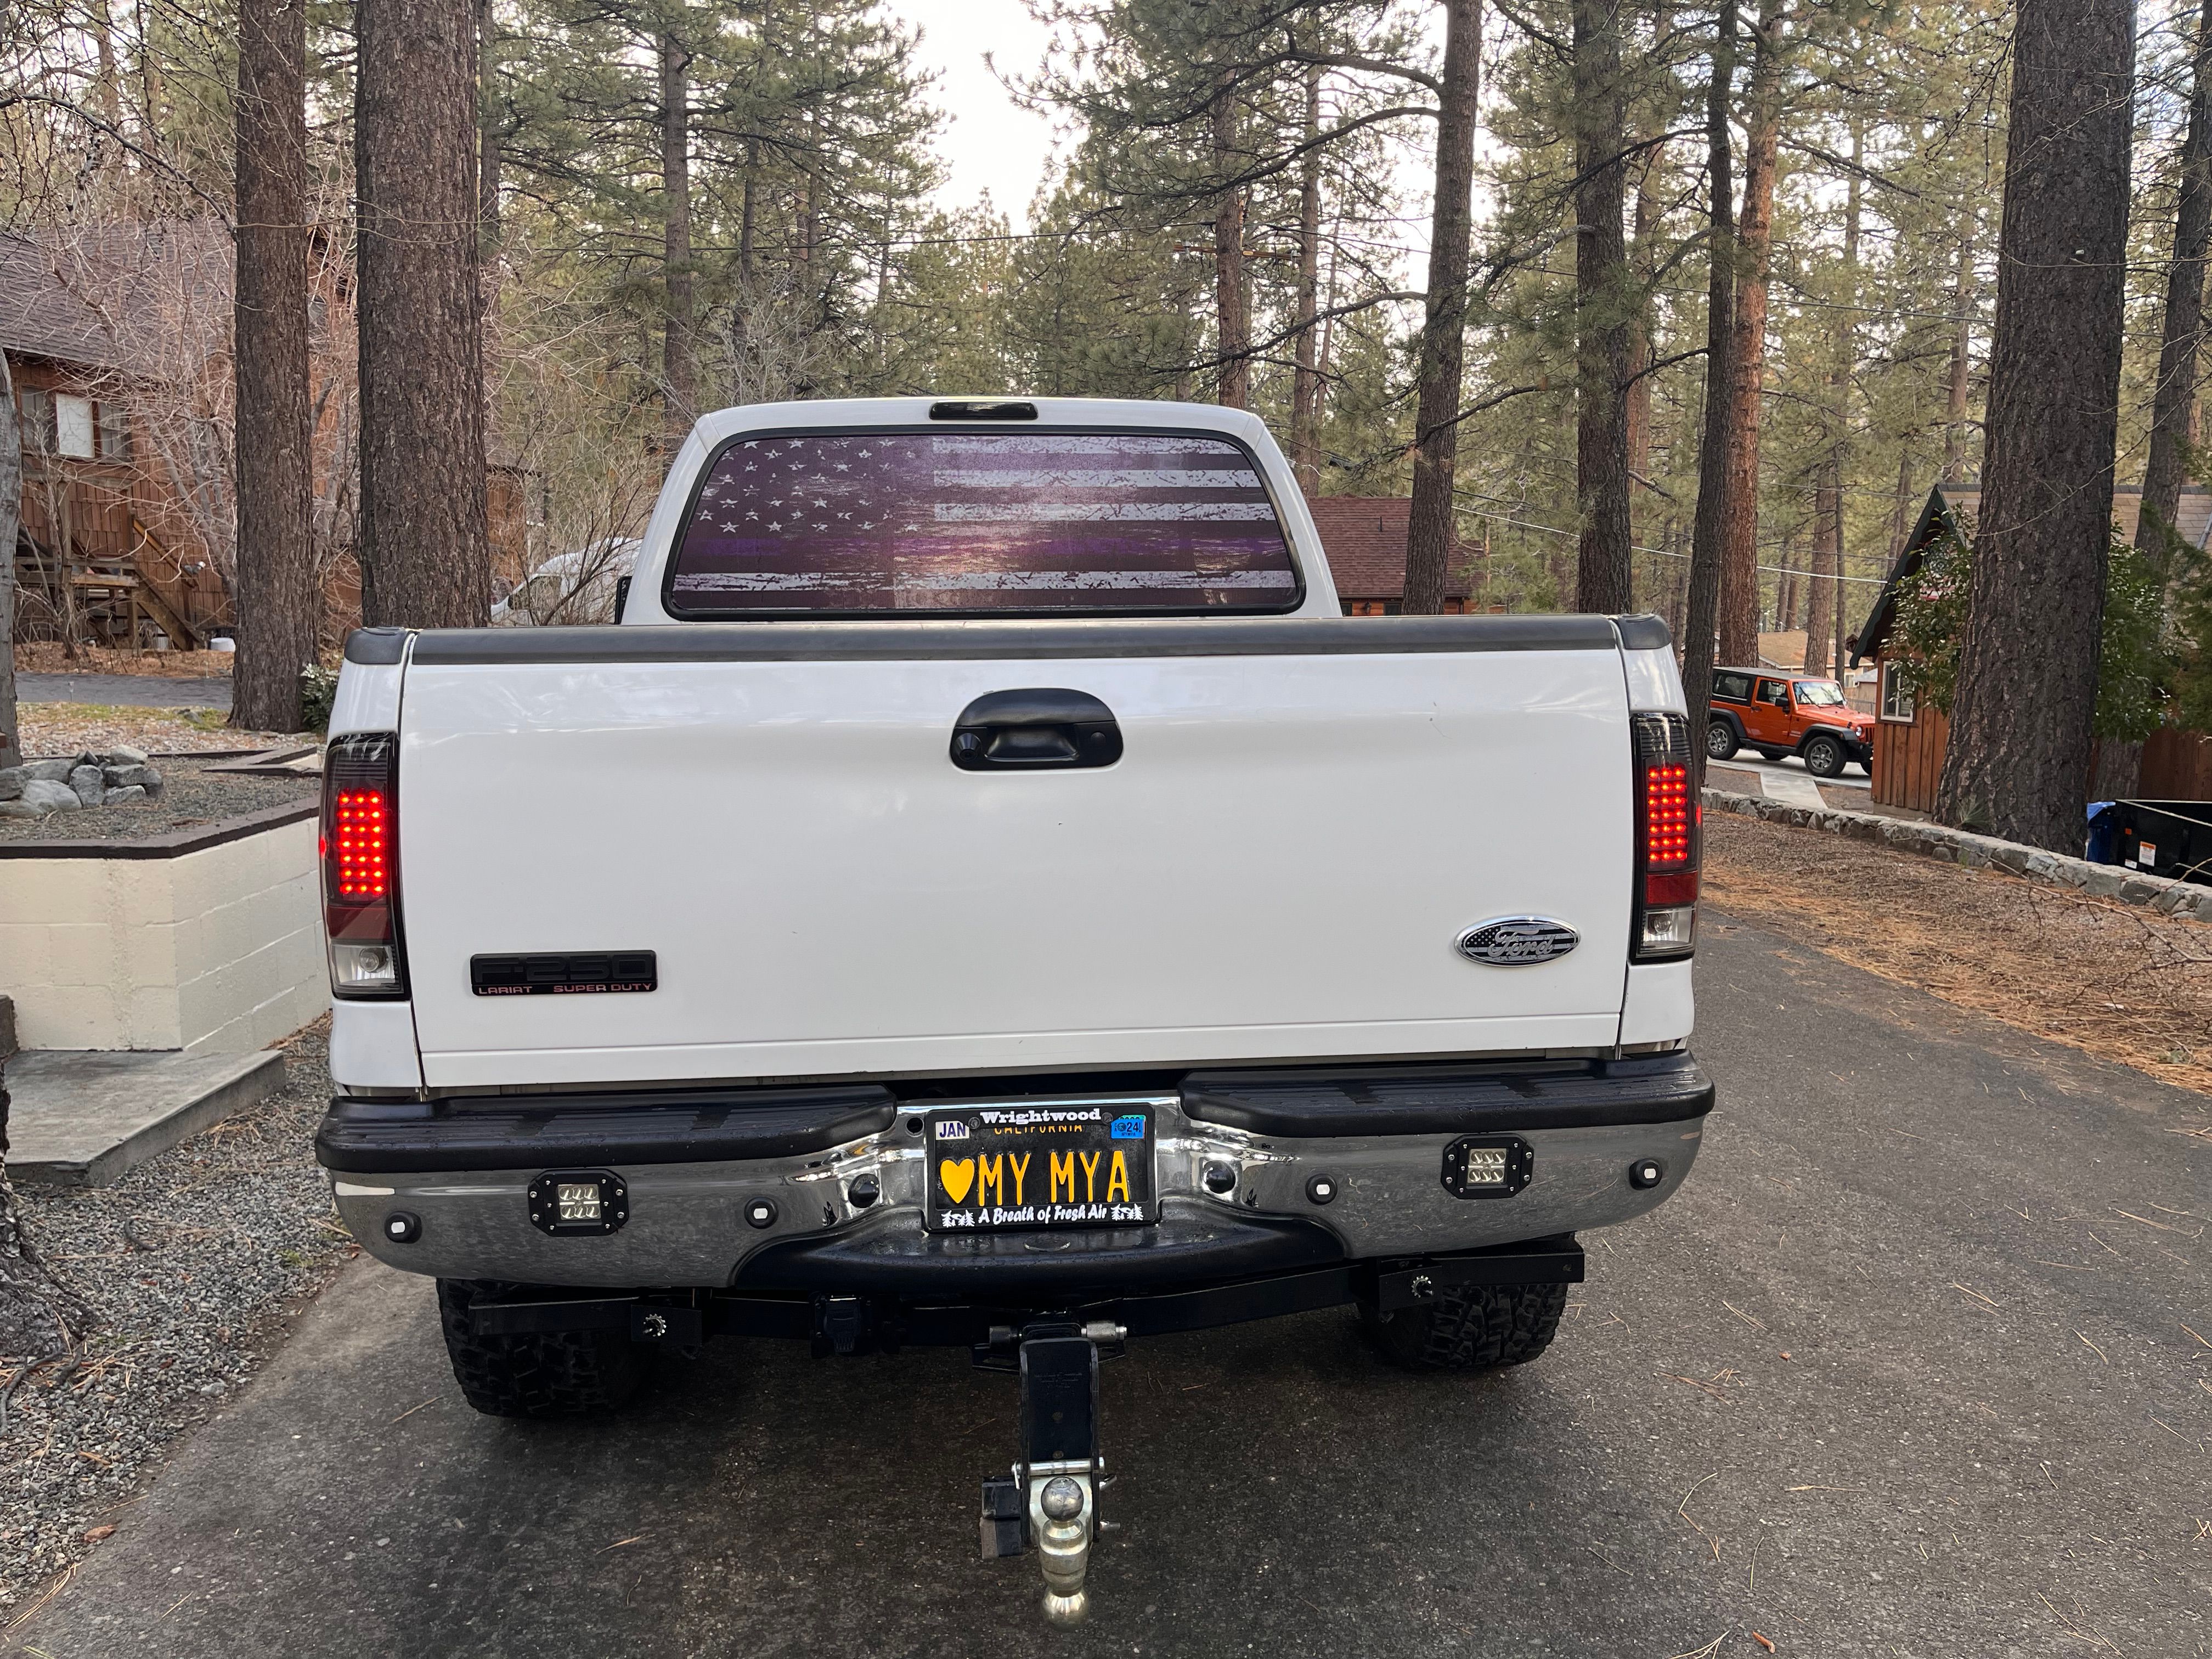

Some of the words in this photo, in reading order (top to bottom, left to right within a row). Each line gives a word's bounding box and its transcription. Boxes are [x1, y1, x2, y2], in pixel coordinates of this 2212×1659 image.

[1487, 929, 1556, 957] Ford
[478, 986, 533, 995] LARIAT
[553, 984, 607, 993] SUPER
[610, 983, 652, 992] DUTY
[980, 1108, 1101, 1125] Wrightwood
[939, 1122, 967, 1138] JAN
[978, 1153, 1031, 1206] MY
[978, 1208, 990, 1224] A
[993, 1206, 1035, 1225] Breath
[1037, 1205, 1052, 1224] of
[1054, 1204, 1086, 1221] Fresh
[1088, 1204, 1107, 1220] Air
